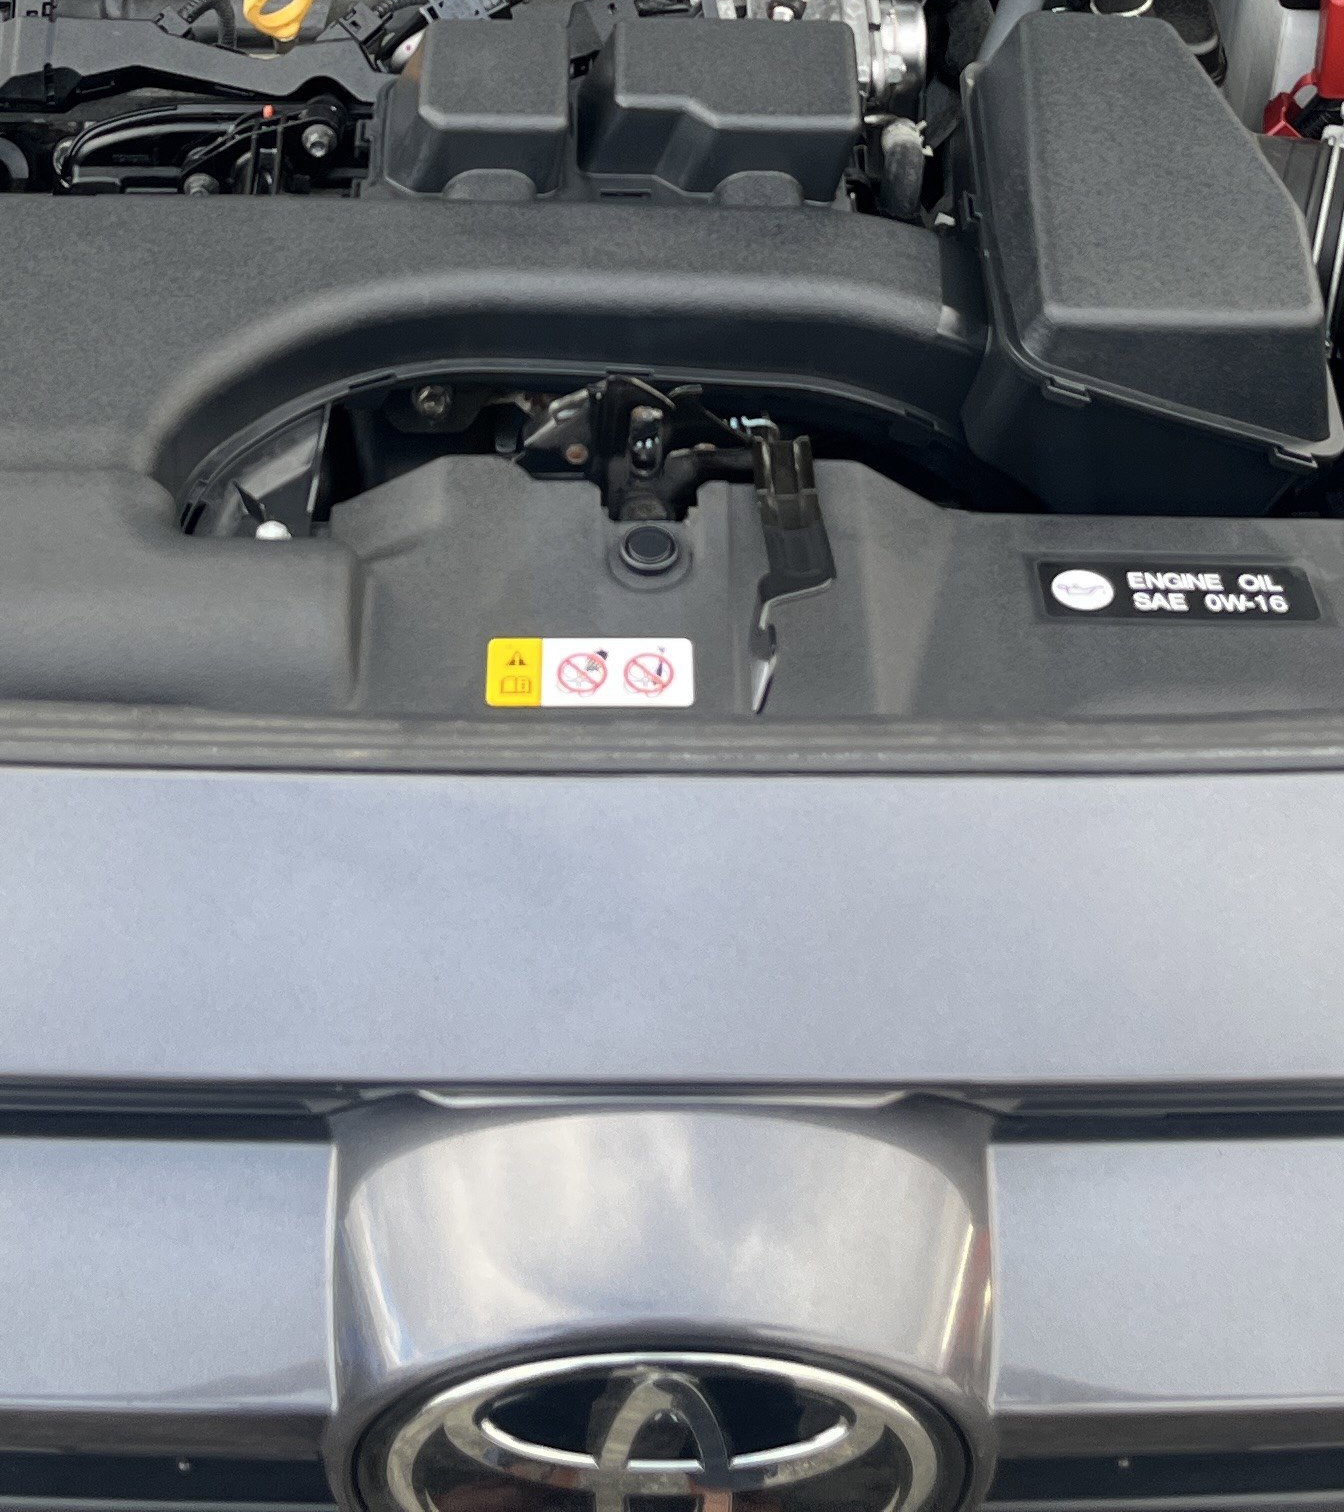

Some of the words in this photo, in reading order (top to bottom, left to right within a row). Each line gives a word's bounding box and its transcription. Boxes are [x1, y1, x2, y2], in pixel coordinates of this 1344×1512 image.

[1126, 571, 1224, 591] ENGINE
[1237, 574, 1283, 592] OIL
[1132, 592, 1190, 612] SAE
[1205, 594, 1290, 614] 0W-16
